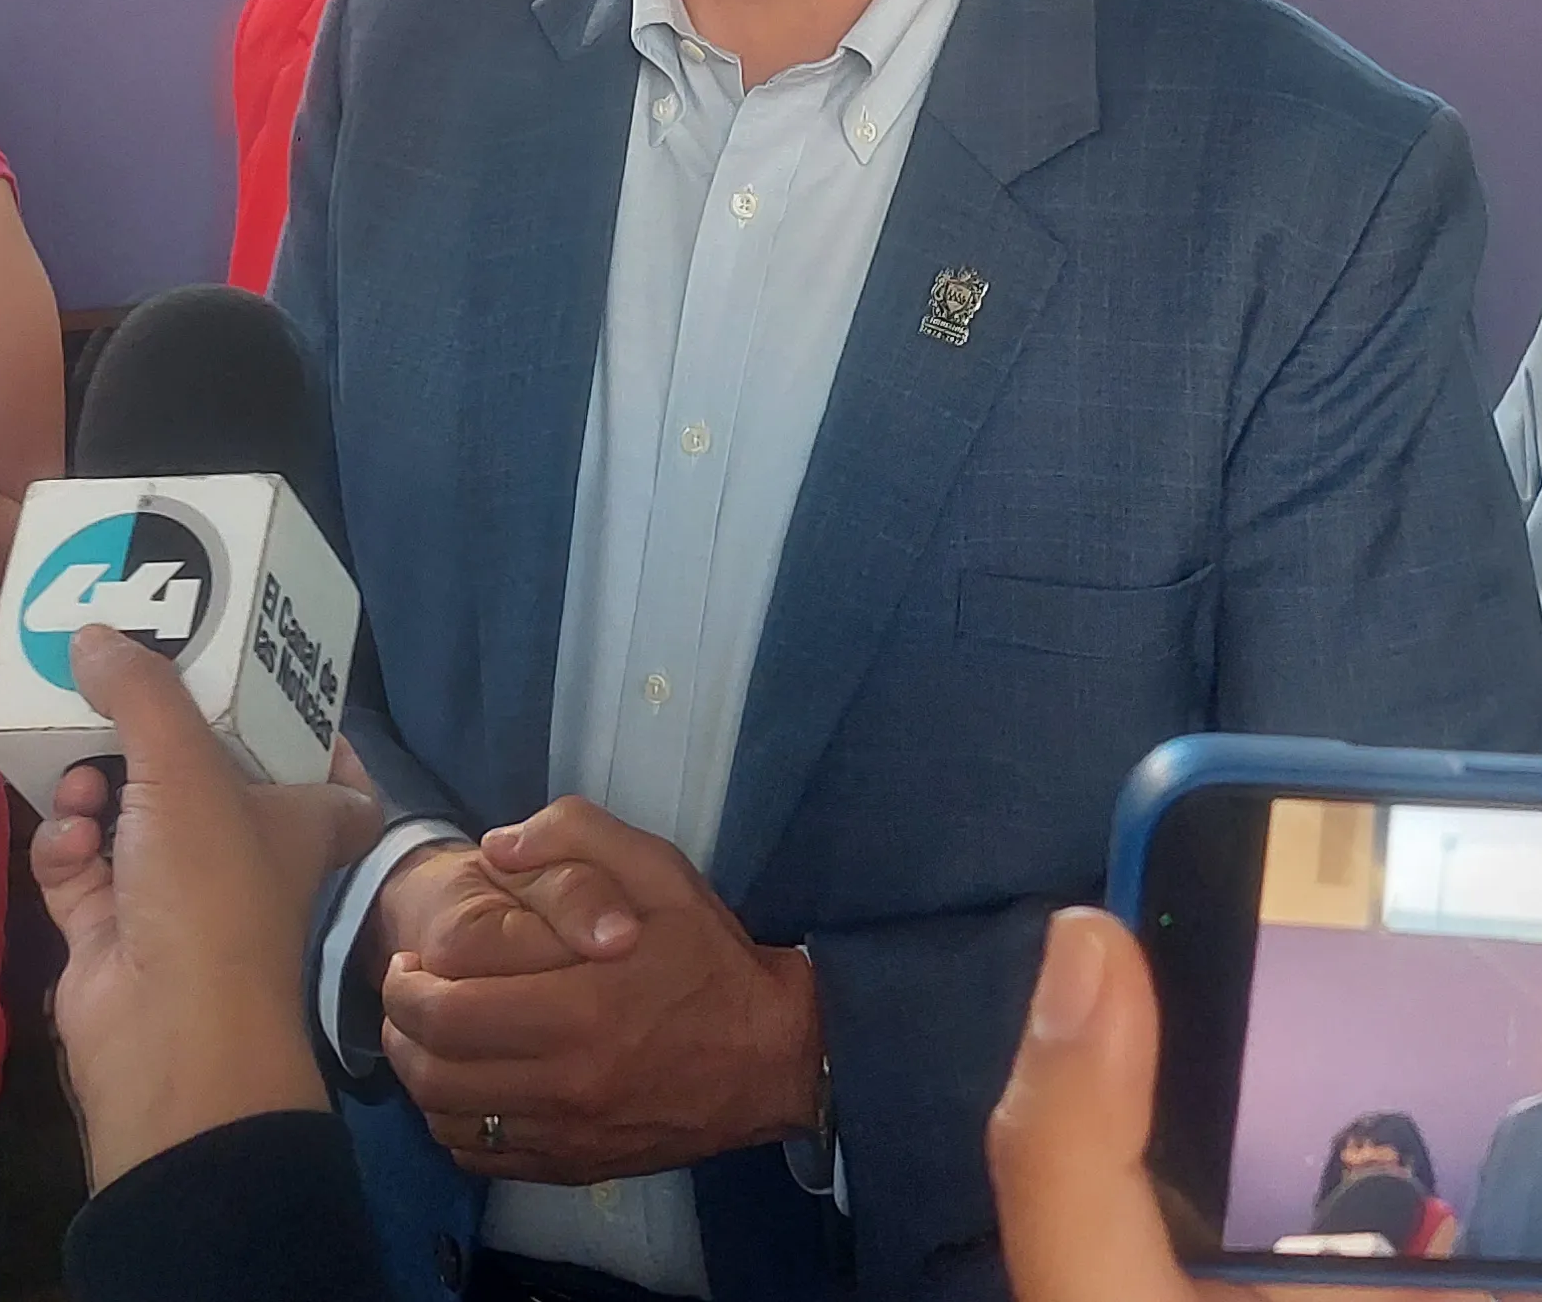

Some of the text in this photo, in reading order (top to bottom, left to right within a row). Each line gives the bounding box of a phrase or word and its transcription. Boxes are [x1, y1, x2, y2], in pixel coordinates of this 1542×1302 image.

[23, 560, 202, 640] 44
[262, 572, 338, 706] El Canal de
[253, 612, 334, 752] las Noticias
